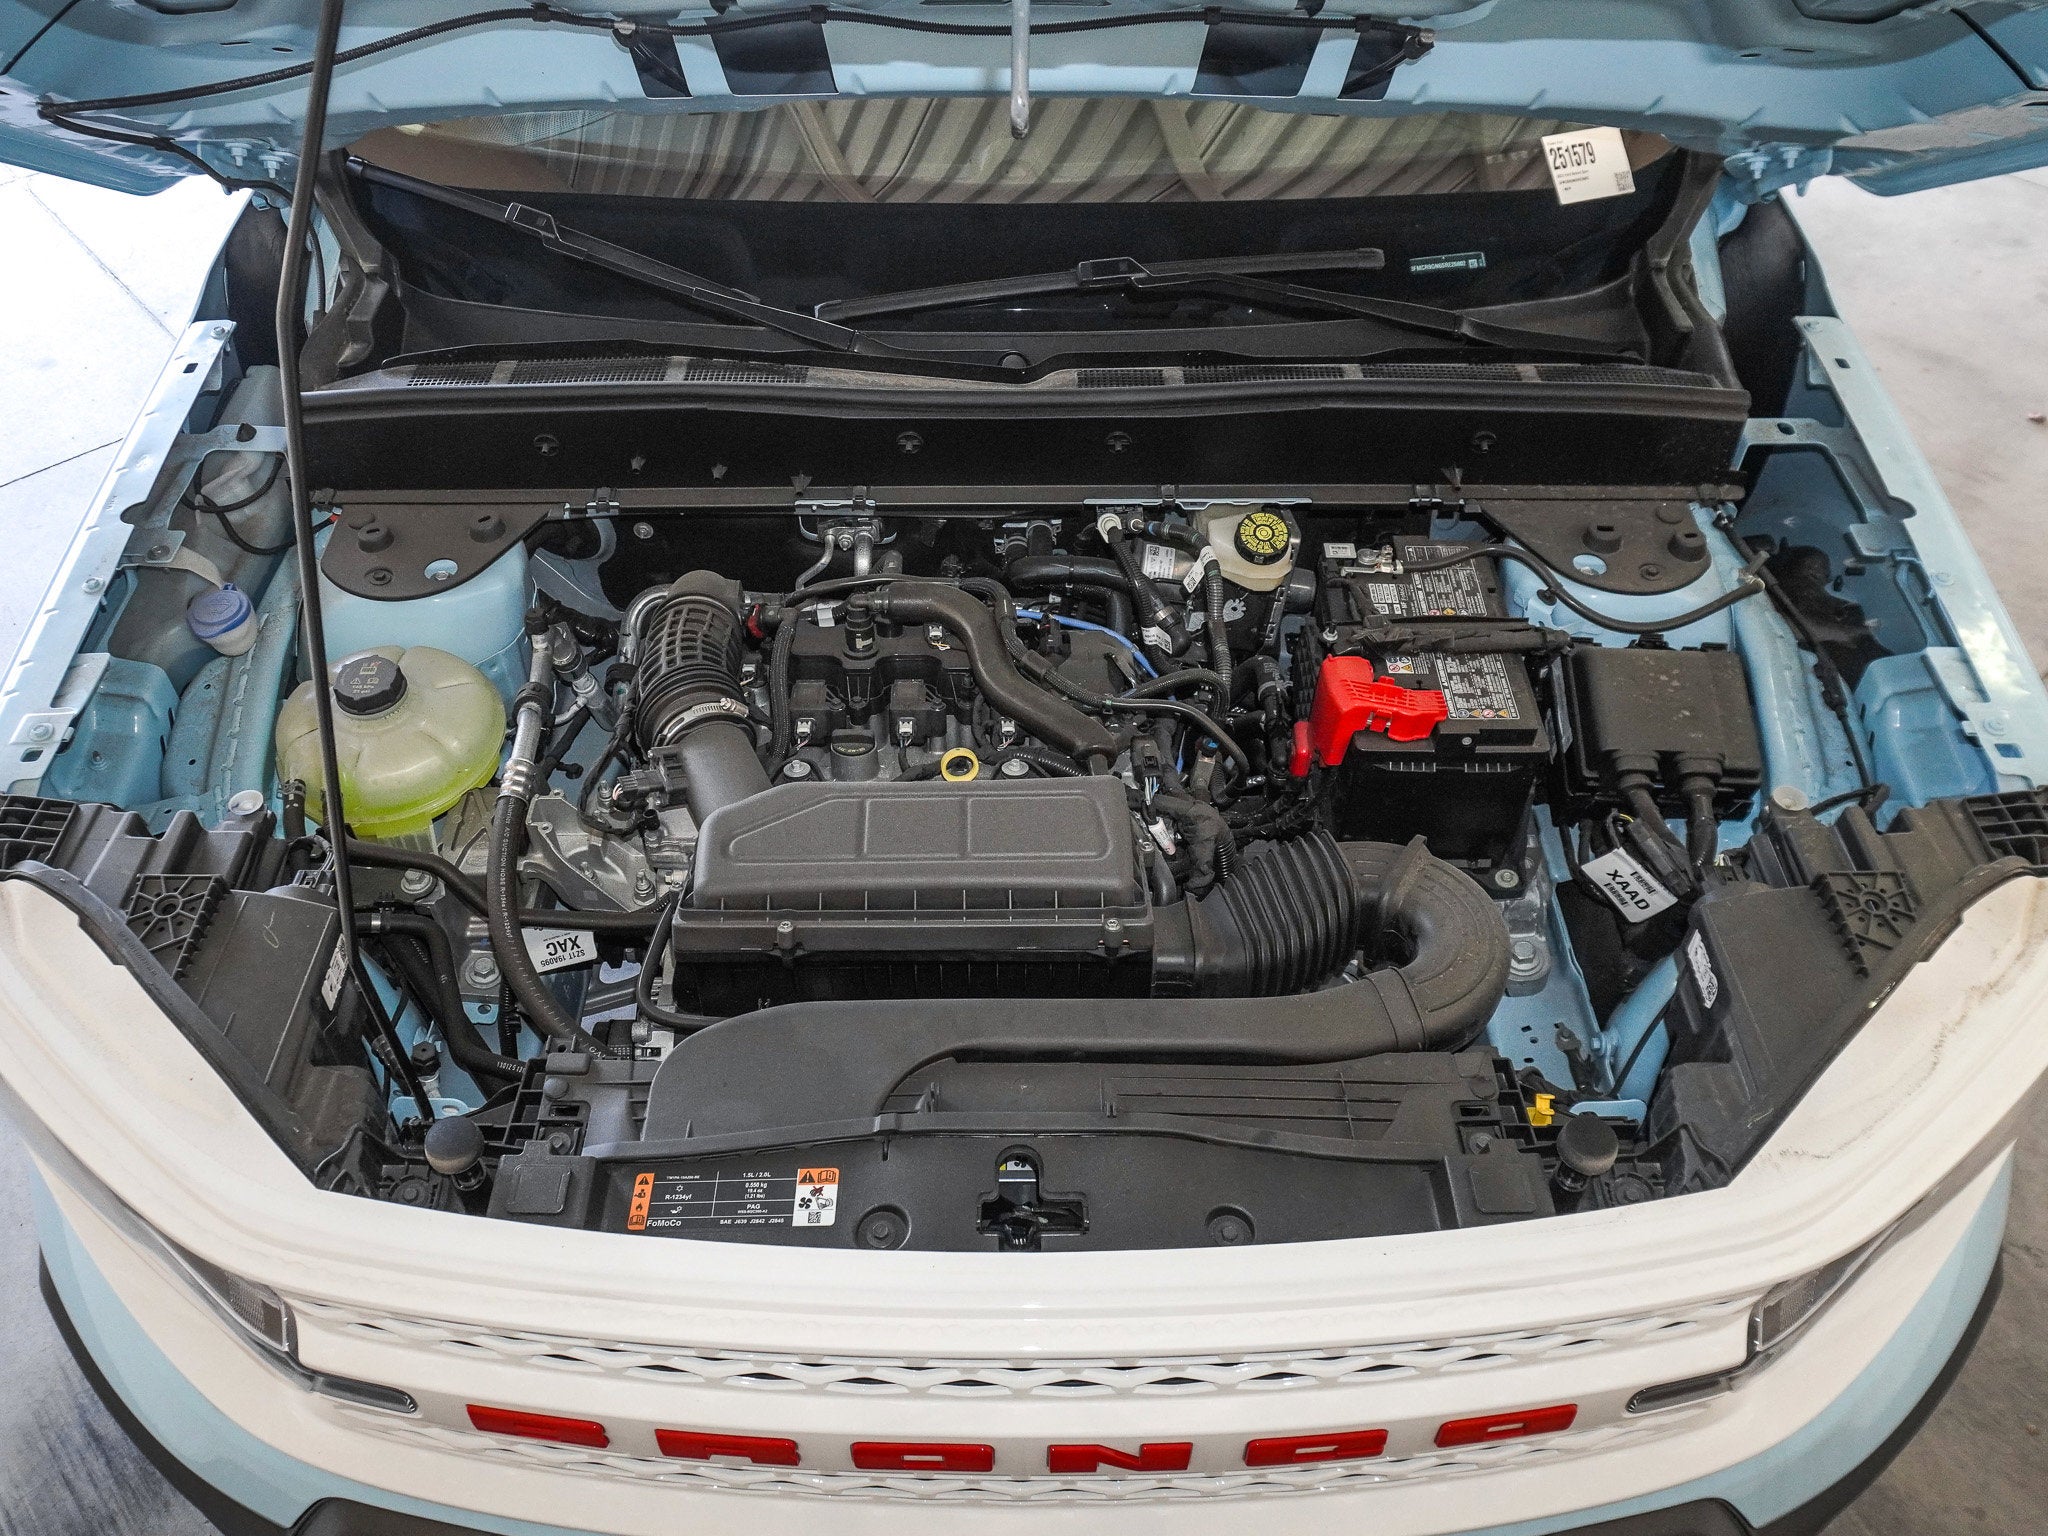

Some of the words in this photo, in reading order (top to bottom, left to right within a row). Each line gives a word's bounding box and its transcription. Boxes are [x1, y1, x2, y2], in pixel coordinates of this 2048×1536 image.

[1549, 141, 1596, 170] 251579
[500, 838, 508, 866] SUCTION
[1606, 869, 1650, 910] XAAD
[546, 935, 581, 956] XAC
[540, 954, 567, 967] 19A095
[760, 1181, 767, 1189] kg
[646, 1219, 682, 1227] FoMoCo
[466, 1403, 1578, 1474] BRONCO
